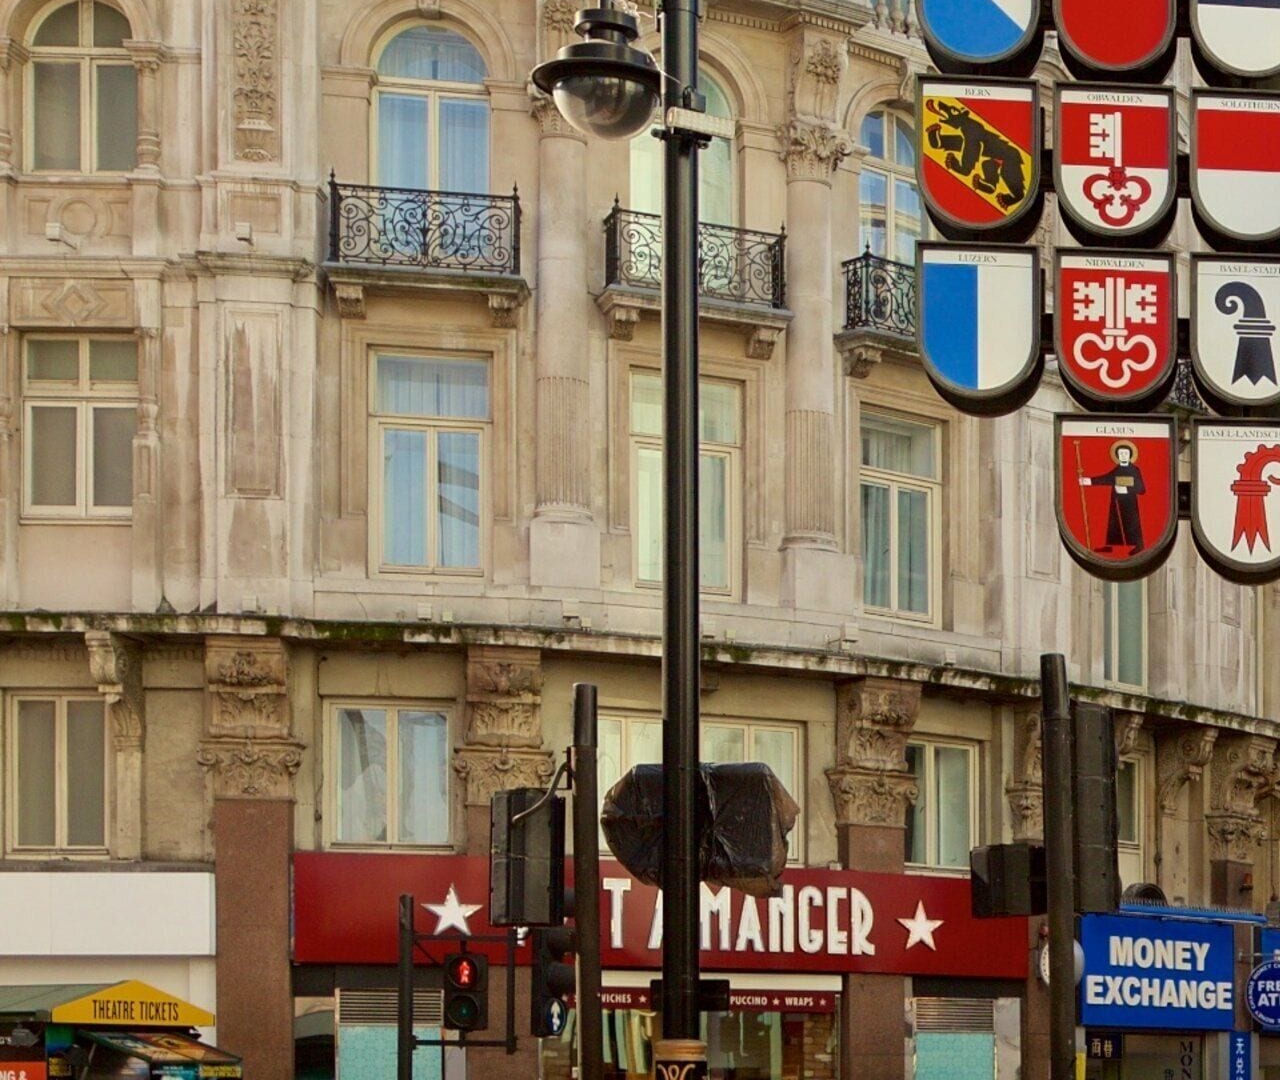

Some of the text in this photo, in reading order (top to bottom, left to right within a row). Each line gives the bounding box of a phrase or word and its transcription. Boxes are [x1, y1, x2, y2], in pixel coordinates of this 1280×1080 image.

[963, 86, 992, 97] BERN
[1086, 92, 1144, 104] OBWALDEN
[1219, 99, 1280, 111] SOLOTHURN
[957, 253, 998, 264] LUZERN
[1084, 258, 1146, 269] NIDWALDEN
[1095, 425, 1135, 436] GLARUS
[700, 881, 875, 956] MANGER
[1109, 936, 1210, 971] MONEY
[1086, 975, 1233, 1010] EXCHANGE
[730, 995, 768, 1007] PUCCINO
[785, 997, 814, 1007] WRAPS
[93, 999, 179, 1021] THEATRE TICKETS
